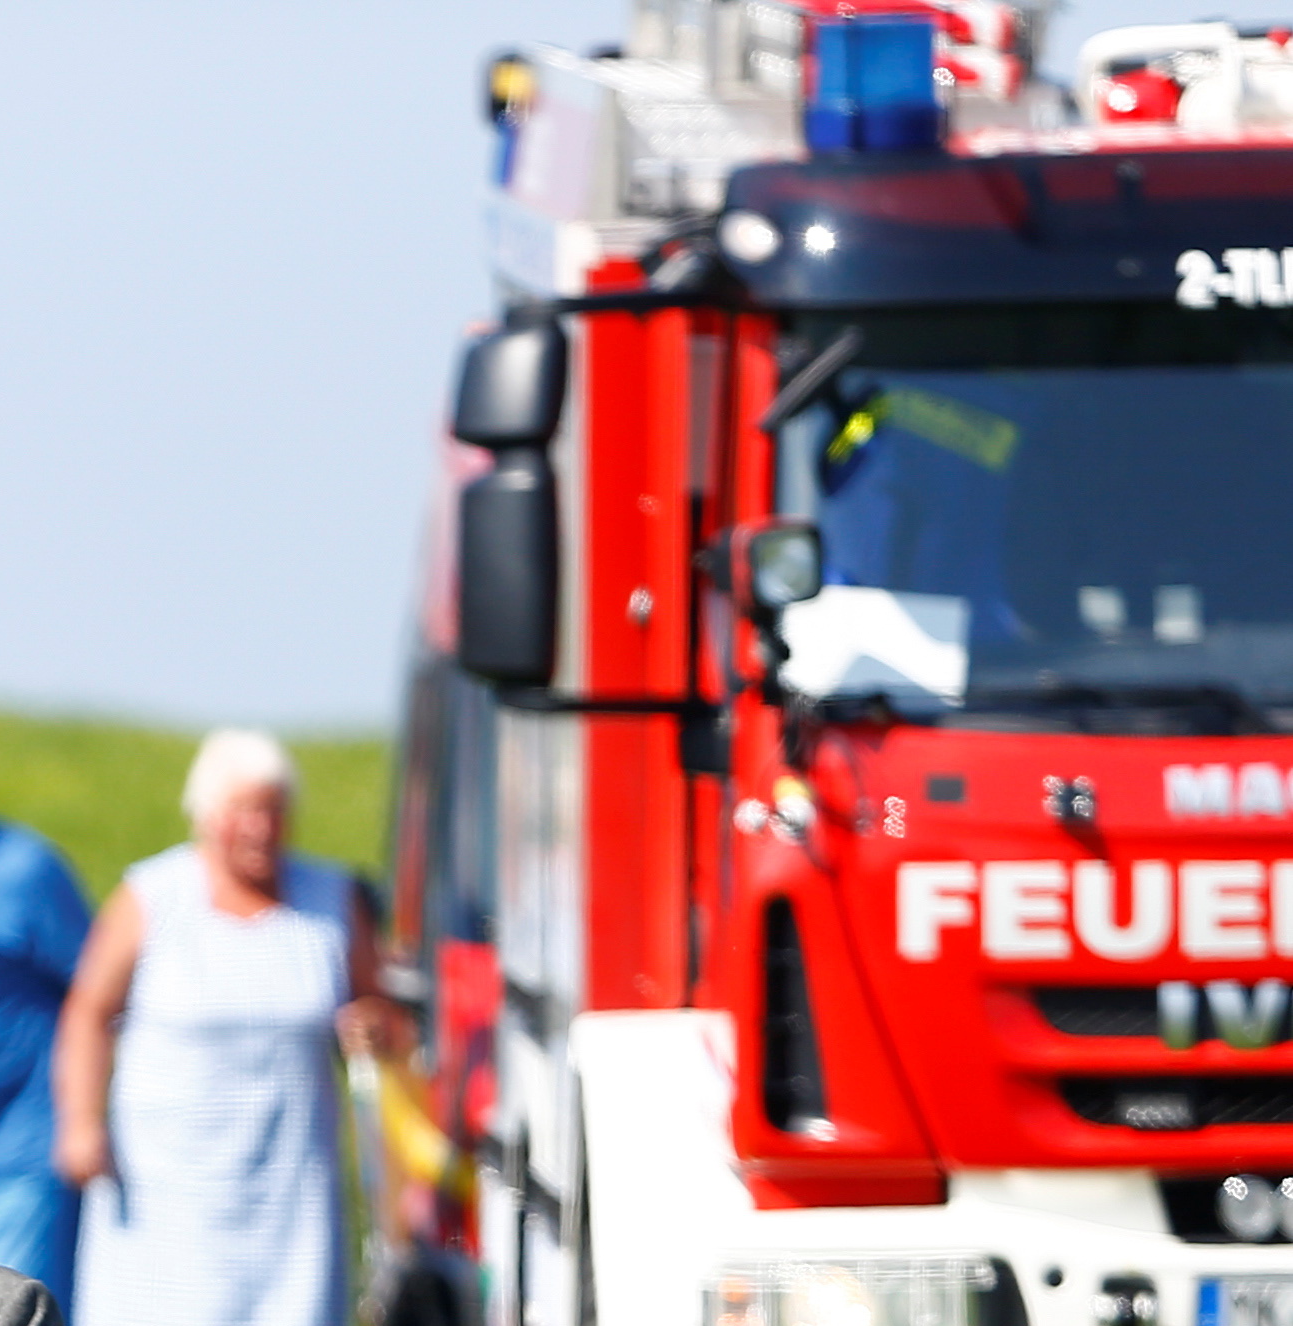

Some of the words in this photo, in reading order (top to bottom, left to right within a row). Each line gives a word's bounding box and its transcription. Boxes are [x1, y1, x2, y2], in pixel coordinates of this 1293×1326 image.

[1163, 760, 1293, 820] MA
[895, 858, 1293, 963] FEUE
[1156, 976, 1293, 1052] IV
